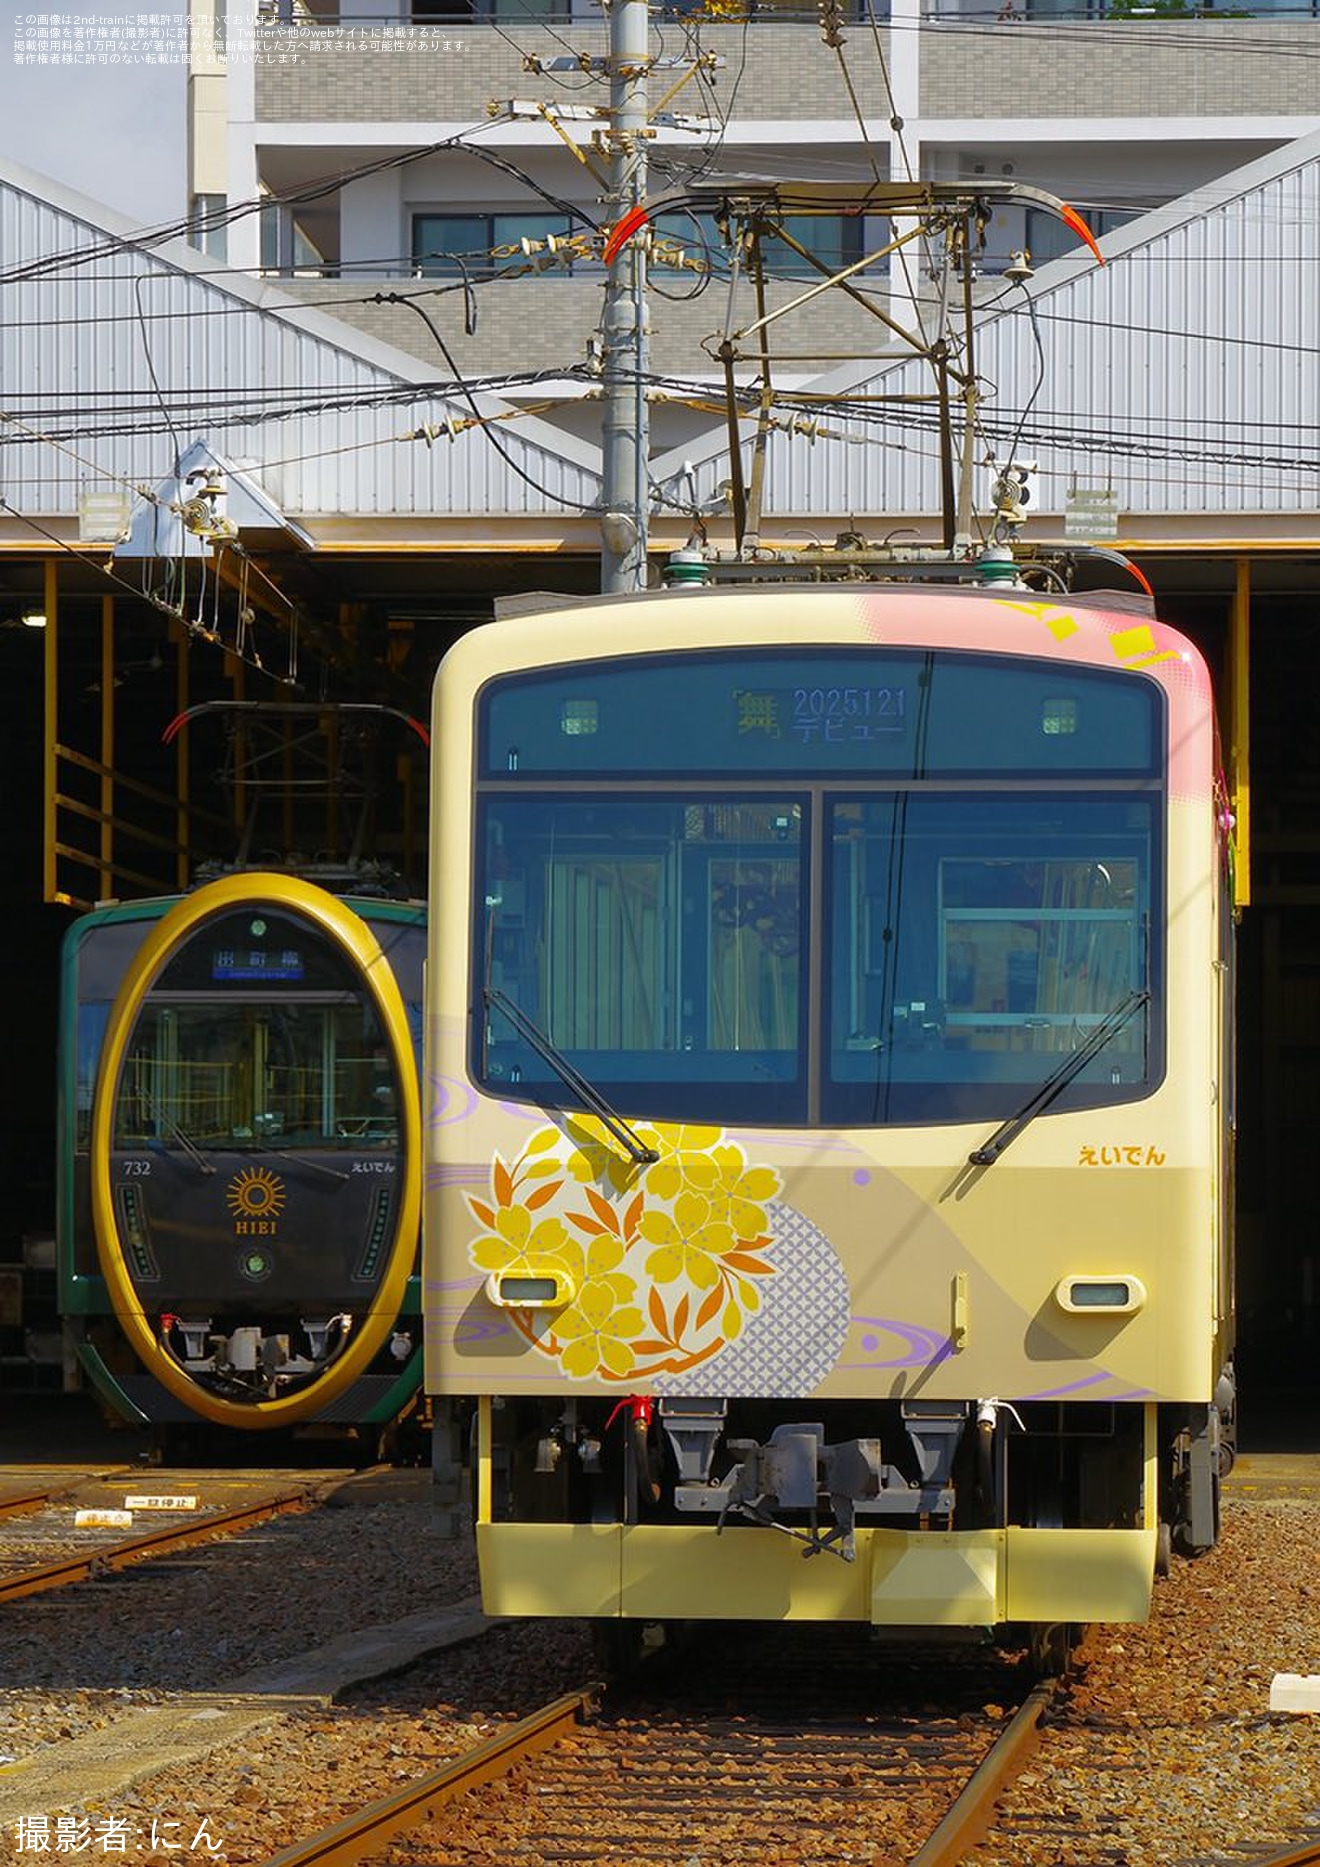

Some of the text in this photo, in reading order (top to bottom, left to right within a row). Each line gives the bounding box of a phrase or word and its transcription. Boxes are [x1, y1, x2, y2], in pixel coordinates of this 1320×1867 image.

[791, 717, 905, 743] デビュー
[1079, 1145, 1166, 1167] えいでん
[123, 1161, 151, 1176] 732
[351, 1161, 396, 1173] えいでん
[235, 1221, 277, 1235] HIEI
